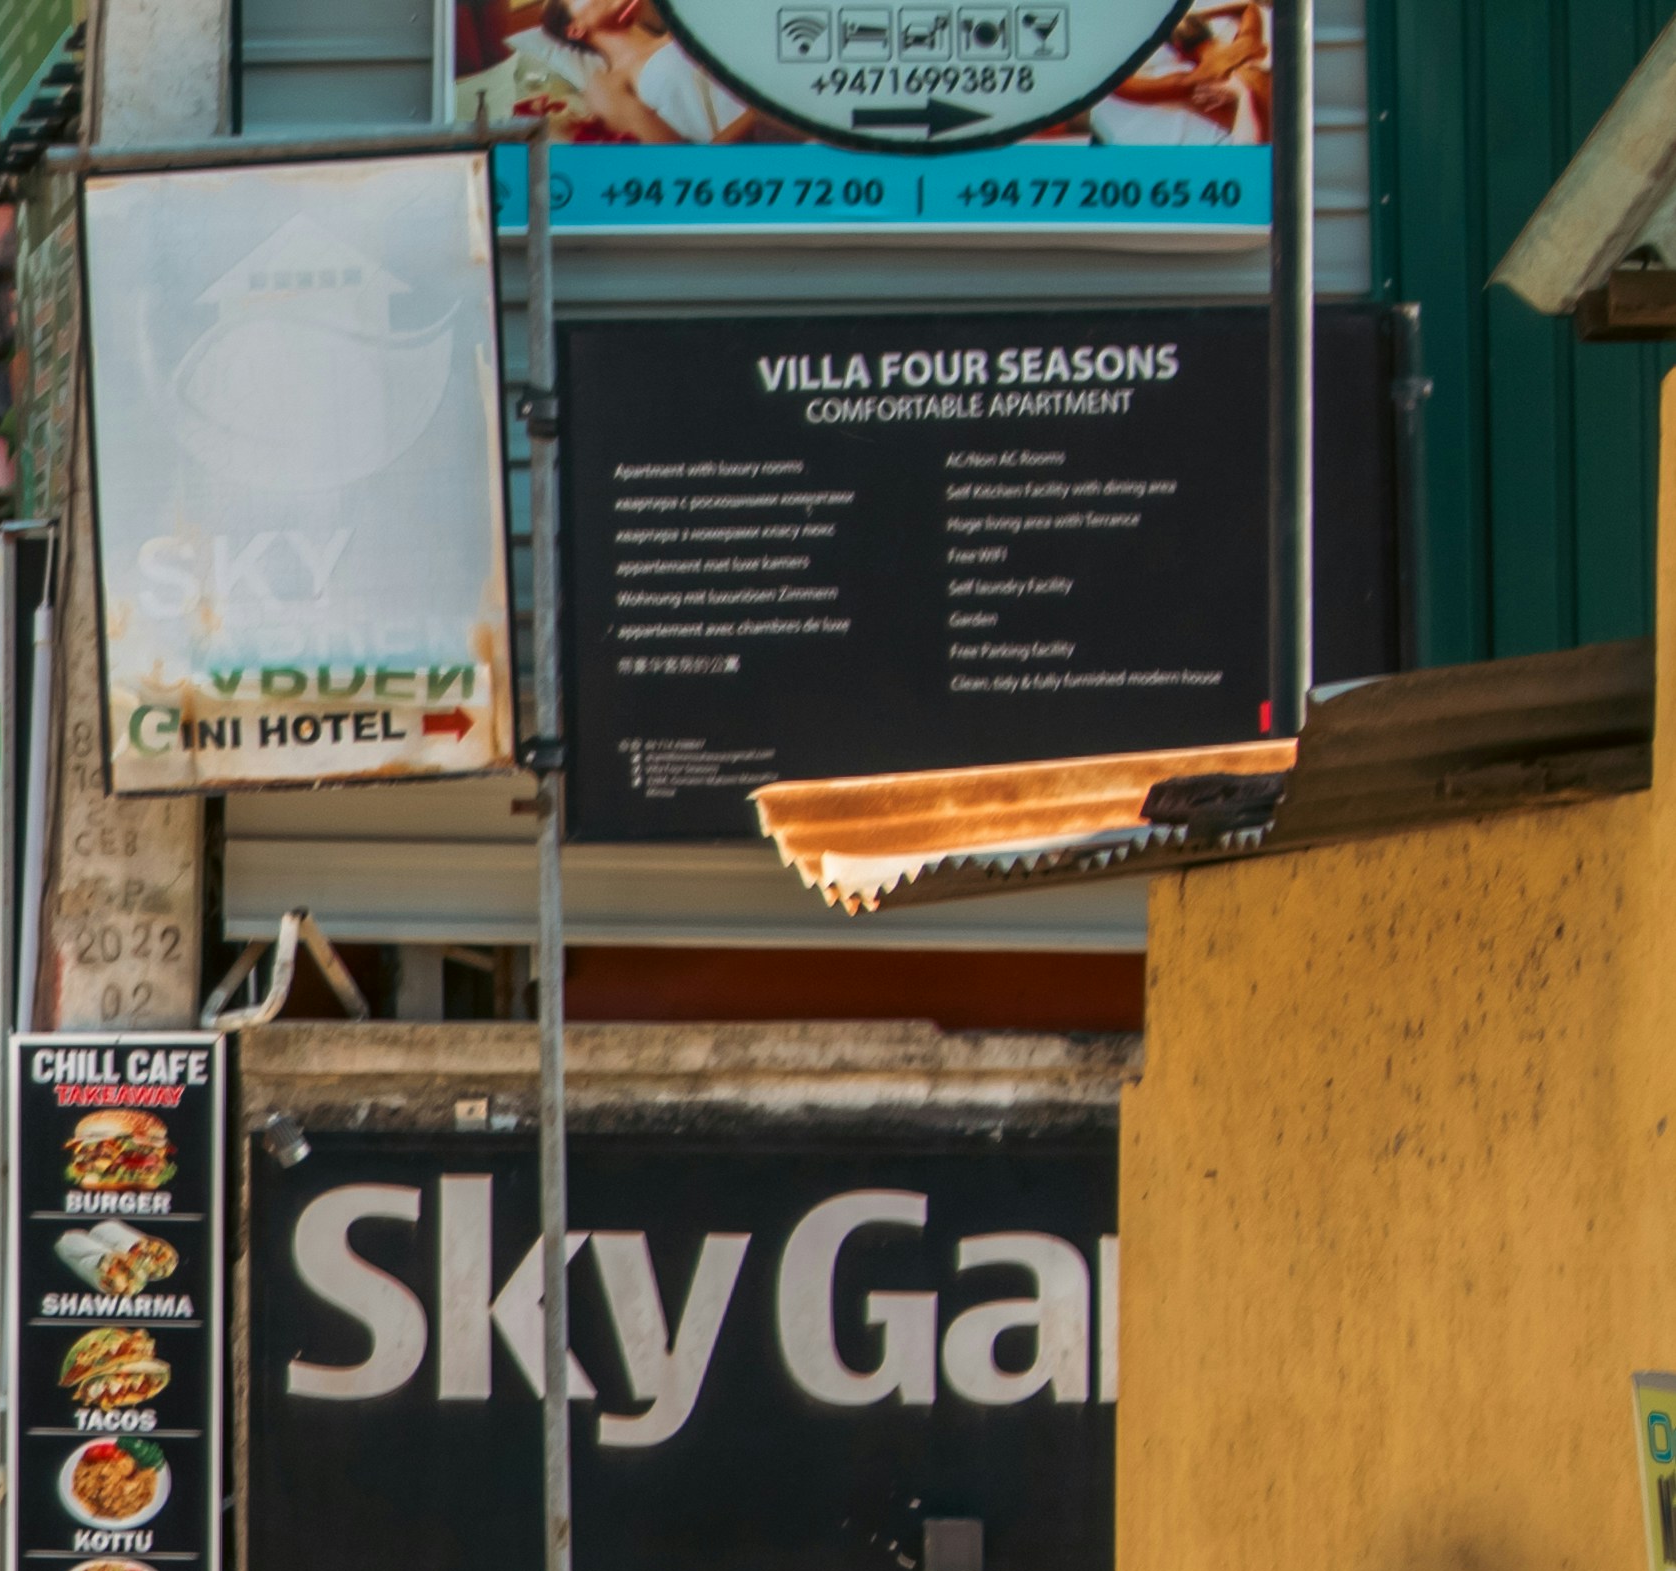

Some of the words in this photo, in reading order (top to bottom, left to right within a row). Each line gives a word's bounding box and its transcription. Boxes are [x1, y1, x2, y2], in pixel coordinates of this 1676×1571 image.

[809, 65, 1035, 97] +94716993878
[601, 178, 665, 209] +94
[672, 178, 715, 209] 76
[722, 178, 791, 209] 697
[796, 178, 836, 209] 72
[842, 177, 885, 208] 00
[961, 178, 1025, 209] +94
[1029, 178, 1070, 209] 77
[1077, 177, 1142, 209] 200
[1151, 176, 1193, 207] 65
[1199, 176, 1242, 207] 40
[758, 353, 871, 392] VILLA
[880, 350, 990, 389] FOUR
[997, 343, 1180, 384] SEASONS
[806, 392, 985, 424] COMFORTABLE
[989, 388, 1135, 418] APARTMENT
[181, 716, 243, 752] INI
[259, 709, 407, 749] HOTEL
[32, 1049, 122, 1085] CHILL
[127, 1050, 210, 1086] CAFE
[54, 1083, 187, 1108] TAKEAWAY
[65, 1190, 173, 1215] BURGER
[41, 1292, 195, 1319] SHAWARMA
[286, 1173, 752, 1447] Sky
[777, 1188, 1120, 1406] Ga
[75, 1407, 158, 1432] TACOS
[73, 1528, 155, 1553] KOTTU
